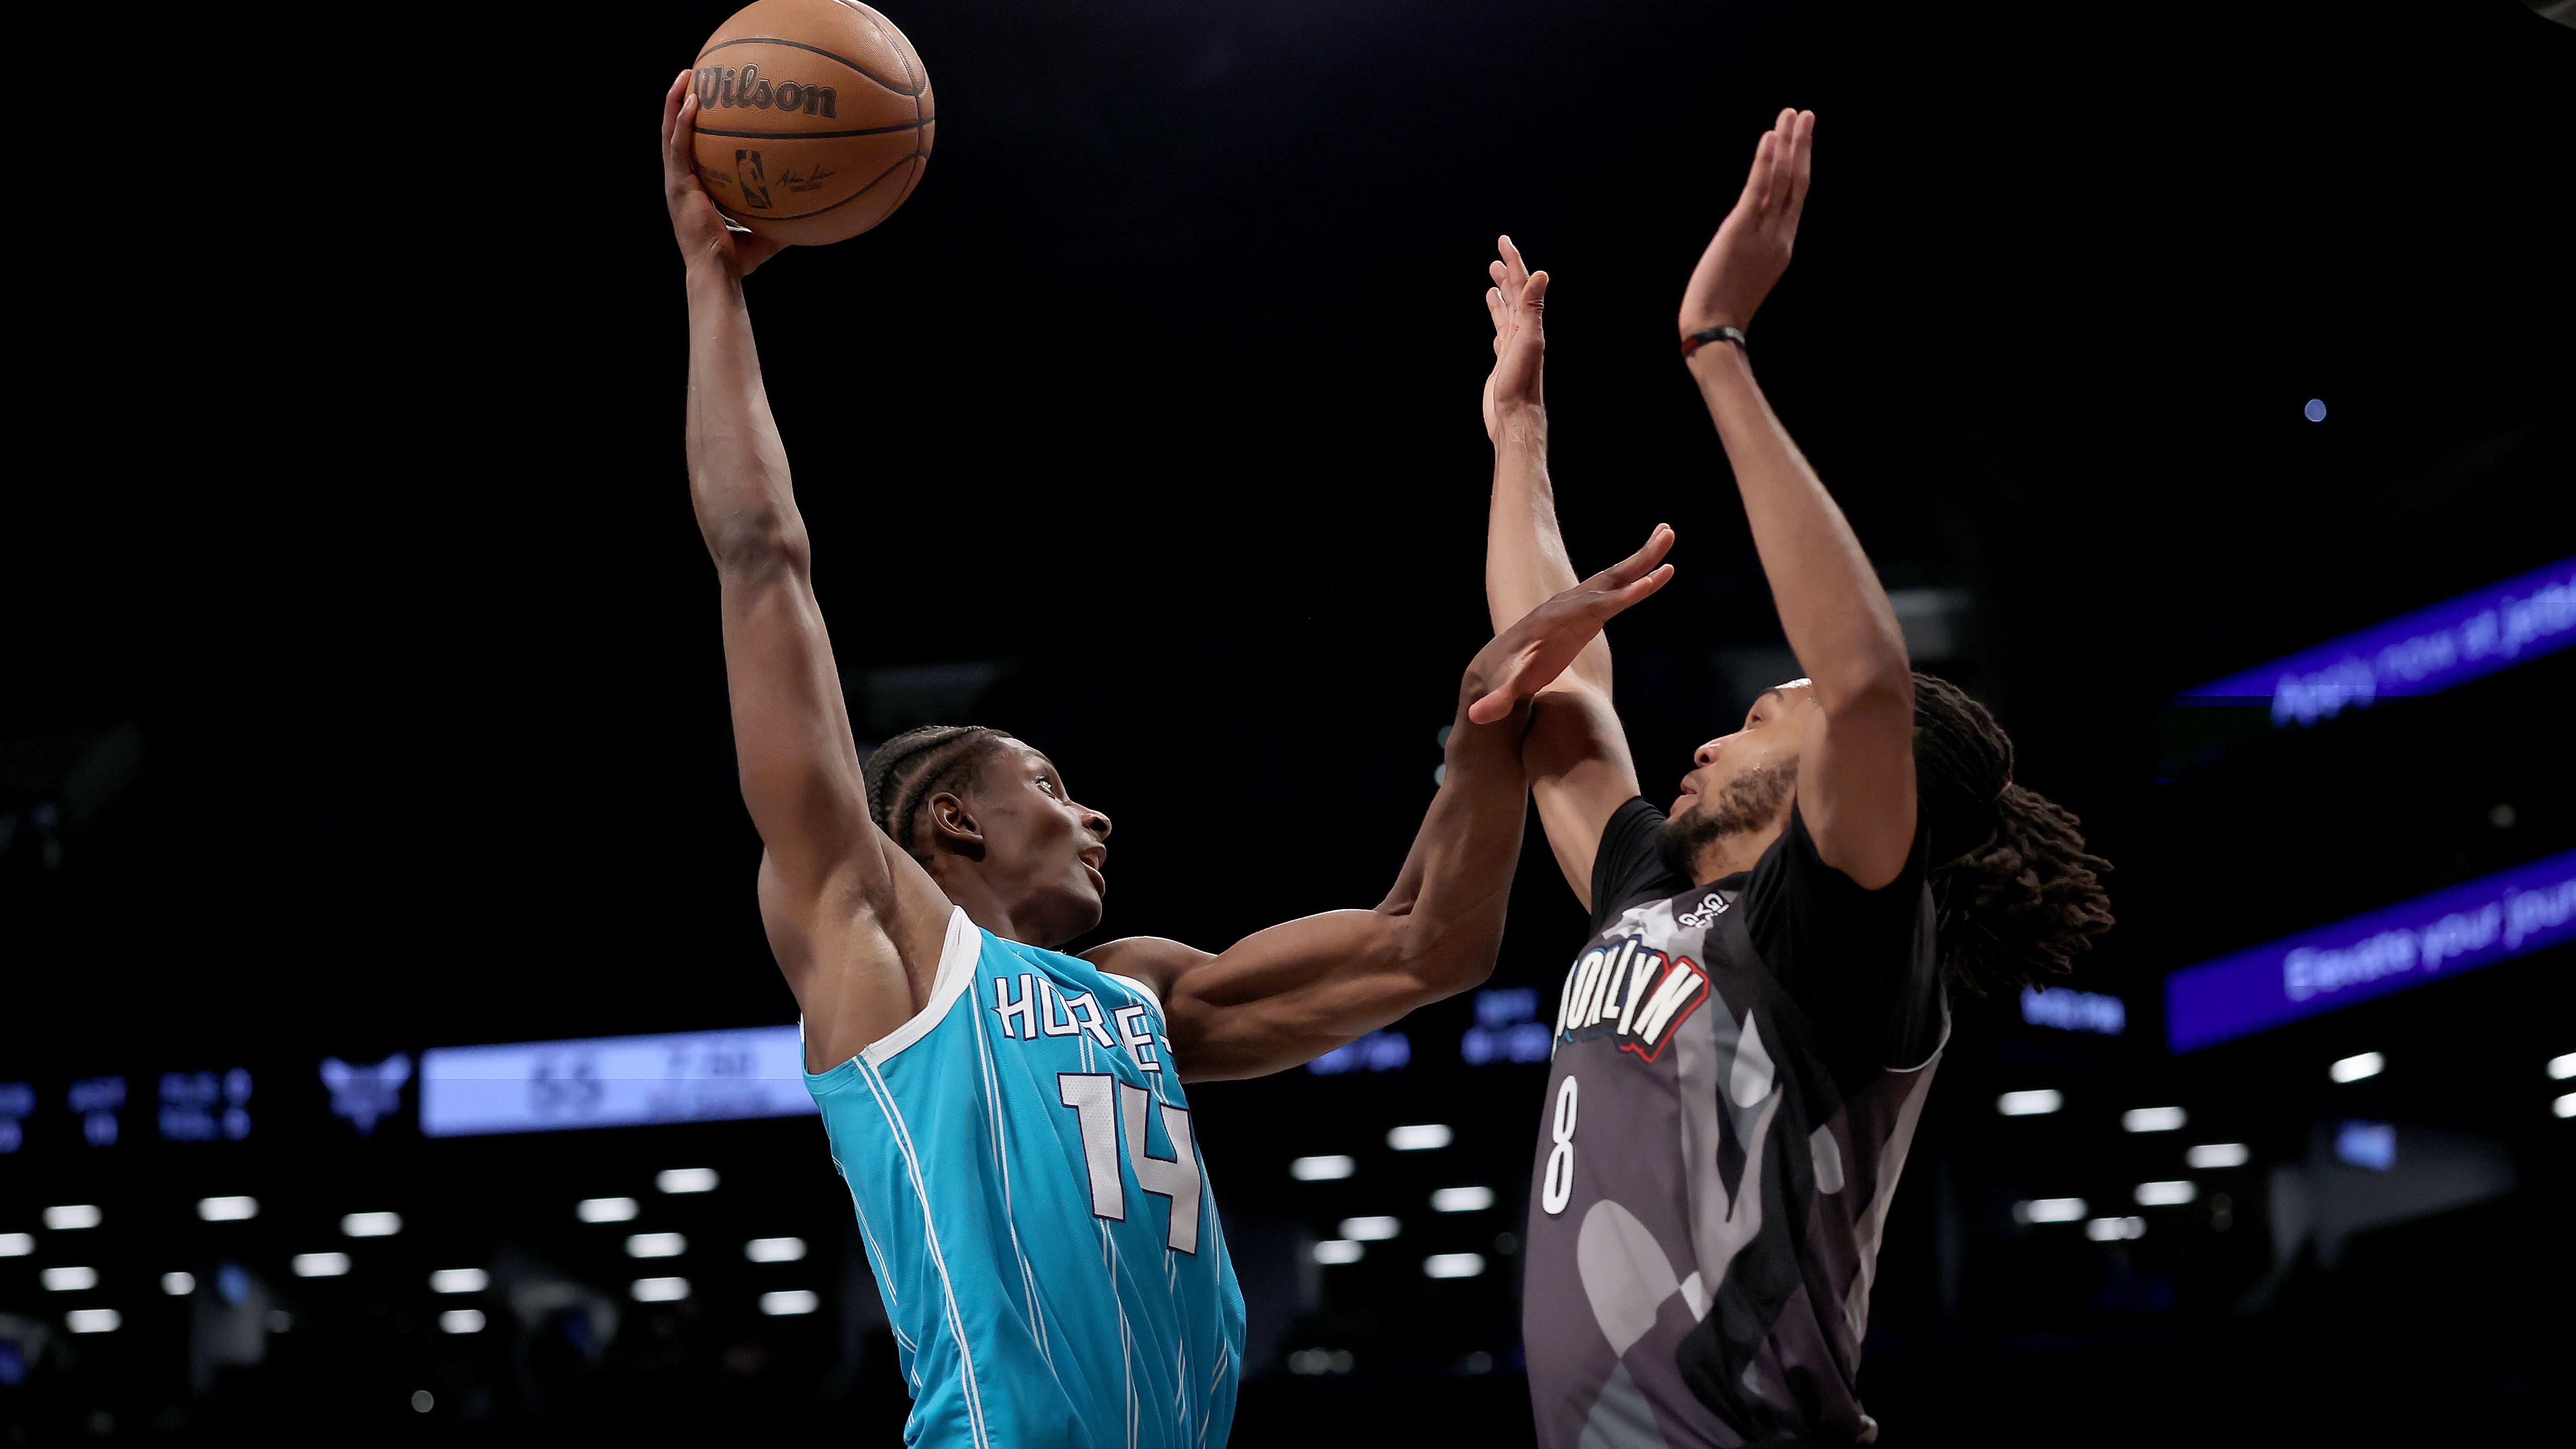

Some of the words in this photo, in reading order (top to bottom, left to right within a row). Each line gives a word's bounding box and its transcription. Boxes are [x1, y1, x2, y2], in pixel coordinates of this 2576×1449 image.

[694, 63, 837, 118] Wilson
[991, 974, 1174, 1072] HORE
[1551, 939, 1704, 1061] OKLYN
[1057, 1072, 1202, 1256] 14
[1542, 1074, 1578, 1214] 8
